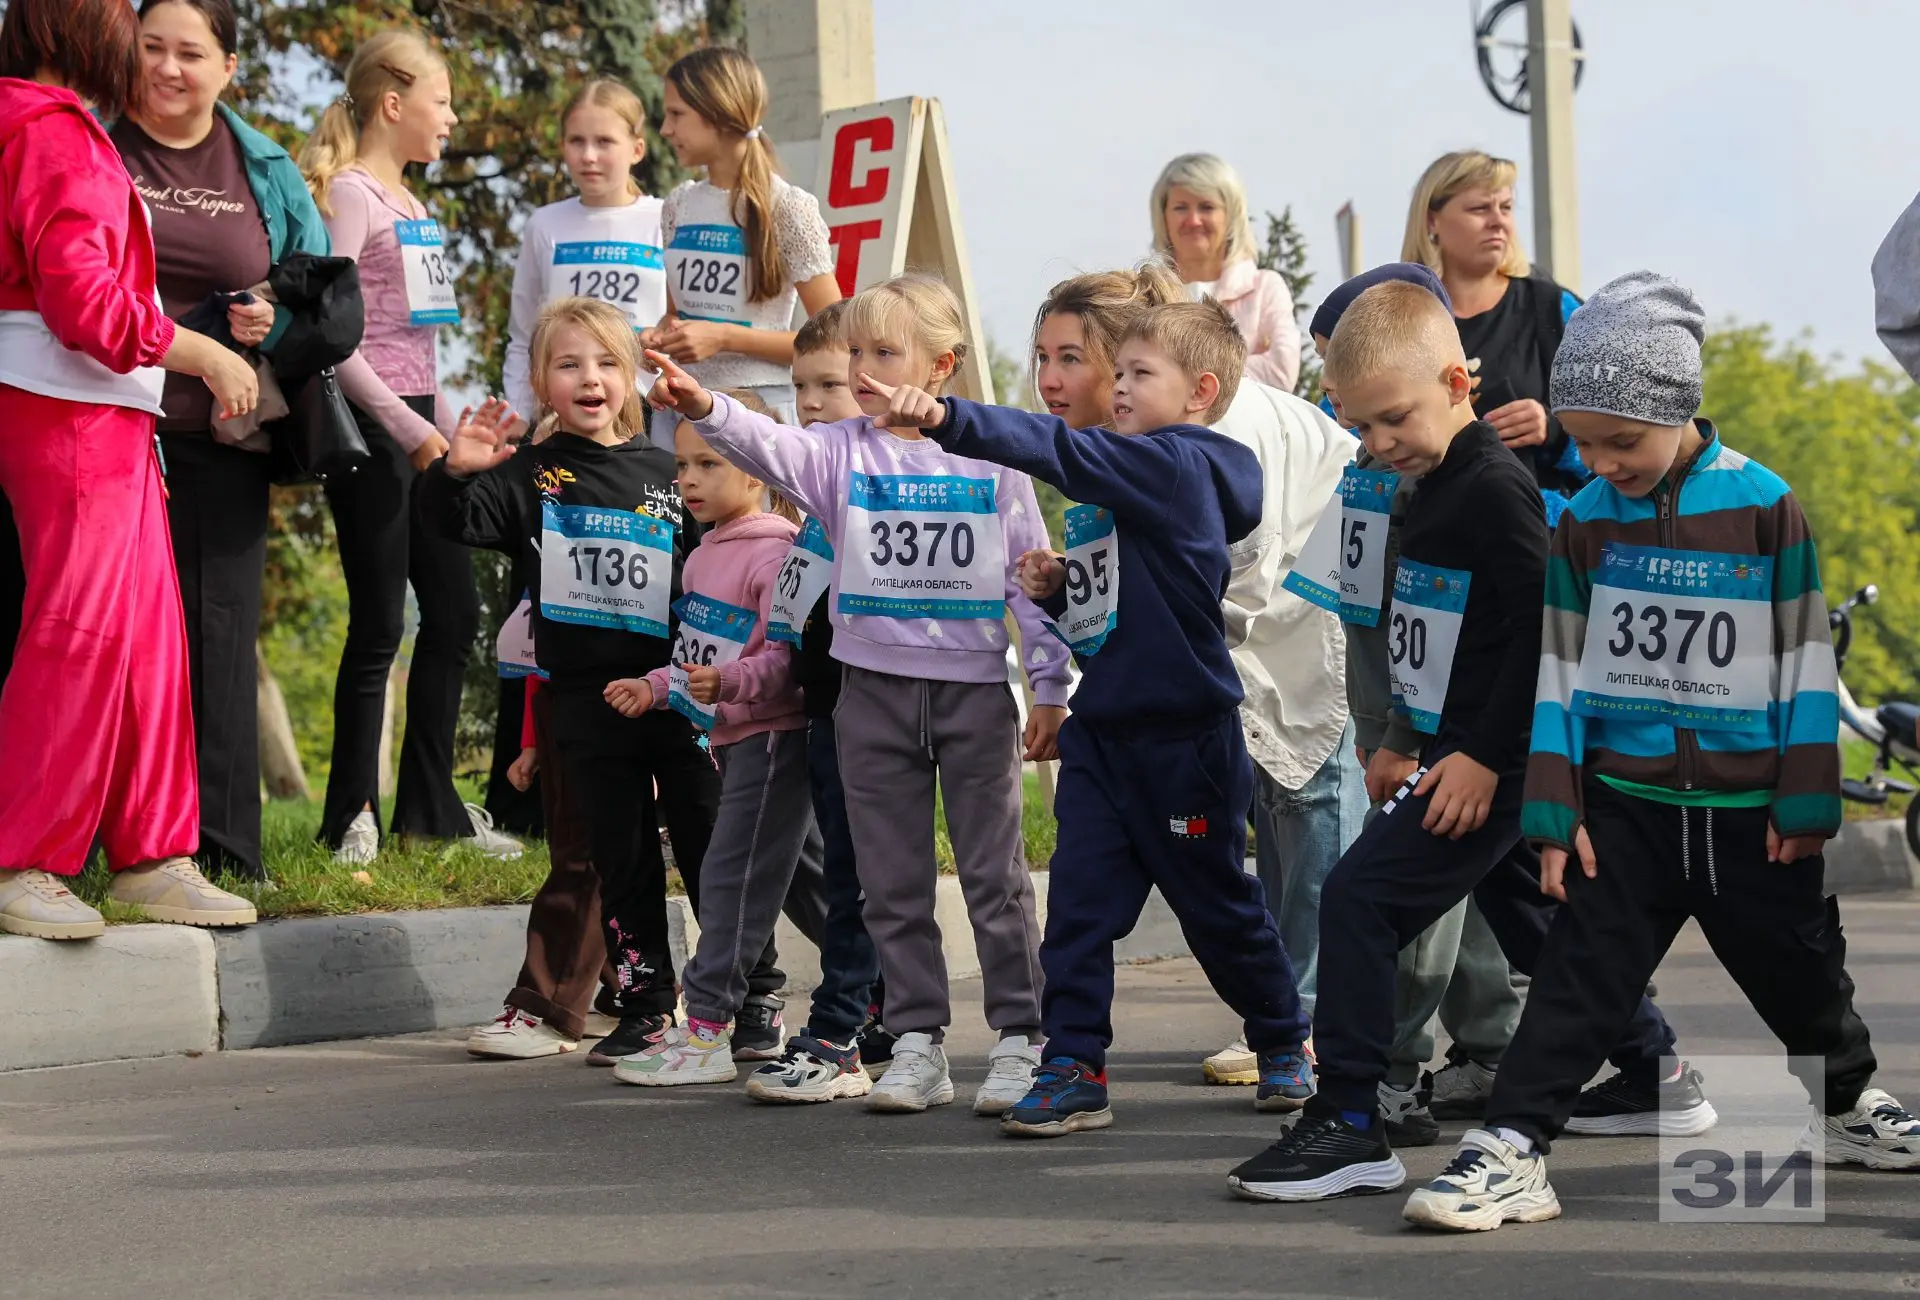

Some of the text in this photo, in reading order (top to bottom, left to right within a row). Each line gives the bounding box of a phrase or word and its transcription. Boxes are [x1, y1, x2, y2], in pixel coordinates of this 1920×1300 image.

[155, 203, 186, 214] FRANCE
[173, 187, 246, 217] Tropez
[570, 270, 640, 304] 1282
[676, 257, 740, 297] 1282
[1593, 364, 1620, 382] IT
[898, 482, 948, 498] КРОСС
[898, 496, 948, 505] НАЦИИ
[584, 525, 630, 536] НАЦИИ
[585, 513, 631, 529] КРОСС
[869, 520, 975, 568] 3370
[568, 546, 649, 590] 1736
[1647, 557, 1708, 579] КРОСС
[871, 577, 973, 590] ЛИПЕЦКАЯ ОБЛАСТЬ
[1646, 575, 1708, 588] НАЦИИ
[1608, 601, 1737, 668] 3370
[1606, 671, 1731, 696] ЛИПЕЦКАЯ ОБЛАСТЬ
